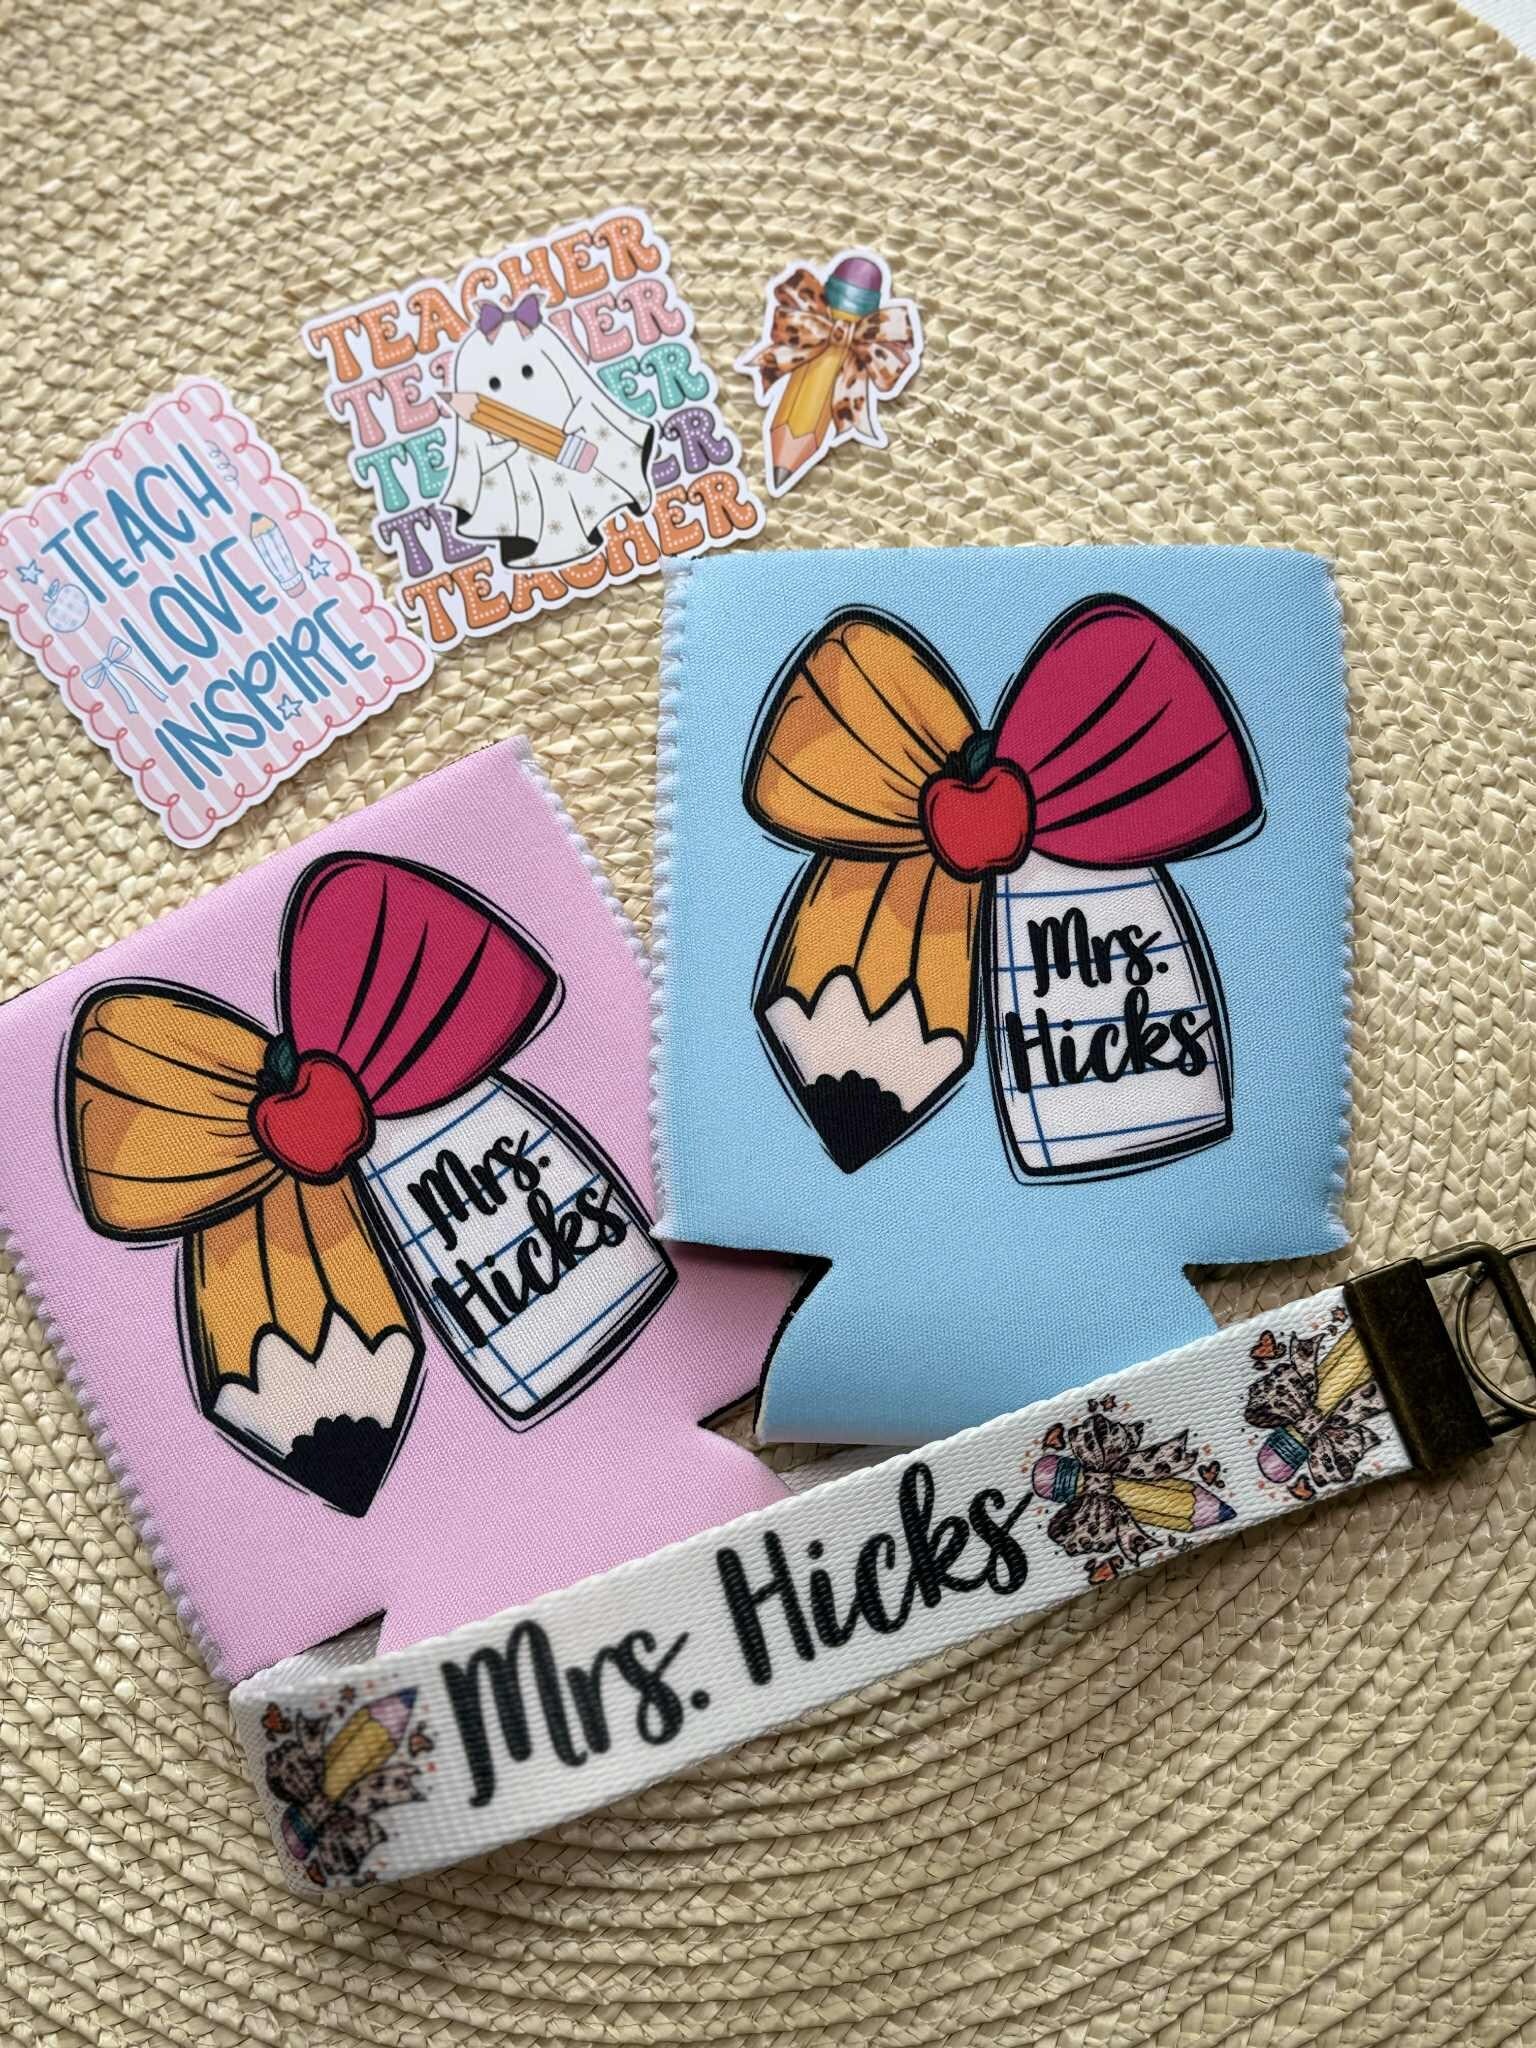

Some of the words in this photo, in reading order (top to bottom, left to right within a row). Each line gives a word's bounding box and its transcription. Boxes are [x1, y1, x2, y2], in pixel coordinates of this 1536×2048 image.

[354, 342, 711, 514] TEER
[41, 443, 233, 603] TEACH
[120, 536, 277, 686] LOVE
[155, 599, 376, 790] INSPIRE
[1027, 907, 1169, 997] Mrs.
[1005, 986, 1214, 1093] Hicks
[407, 1130, 550, 1251] Mrs.
[432, 1184, 627, 1348] Hicks
[440, 1619, 710, 1808] Mrs.
[716, 1461, 1033, 1686] Hicks
